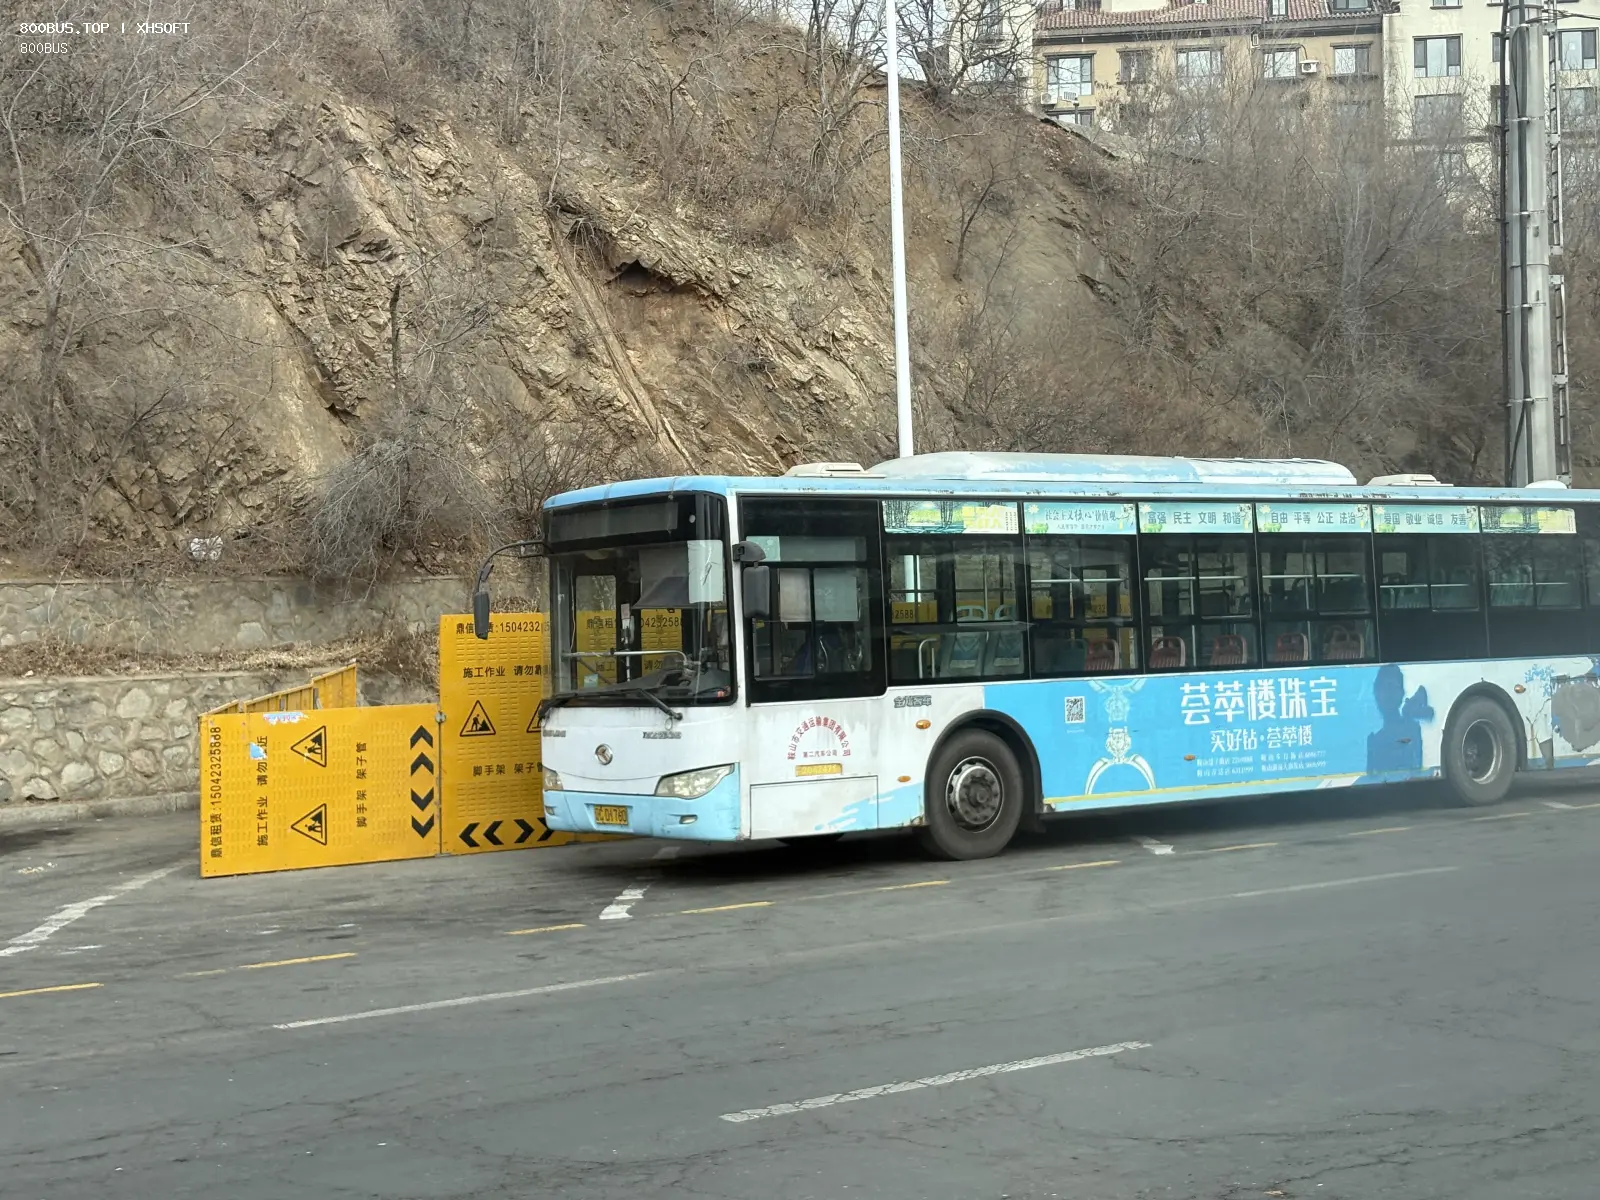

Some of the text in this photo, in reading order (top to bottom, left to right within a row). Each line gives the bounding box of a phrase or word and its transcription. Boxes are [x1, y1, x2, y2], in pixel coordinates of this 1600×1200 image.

[1148, 511, 1241, 525] 富强 民主 文明 和谐
[1271, 511, 1356, 524] 自由 平等 公正 法治
[1384, 513, 1468, 526] 爱国 敬业 诚信 友善
[456, 620, 543, 635] 鼎信赁:1504232
[463, 666, 505, 679] 施工作业
[1180, 675, 1339, 726] 荟萃楼珠宝
[472, 764, 506, 777] 脚手架
[256, 735, 269, 847] 施工作业 请勿近
[355, 741, 368, 828] 脚手架 架子管
